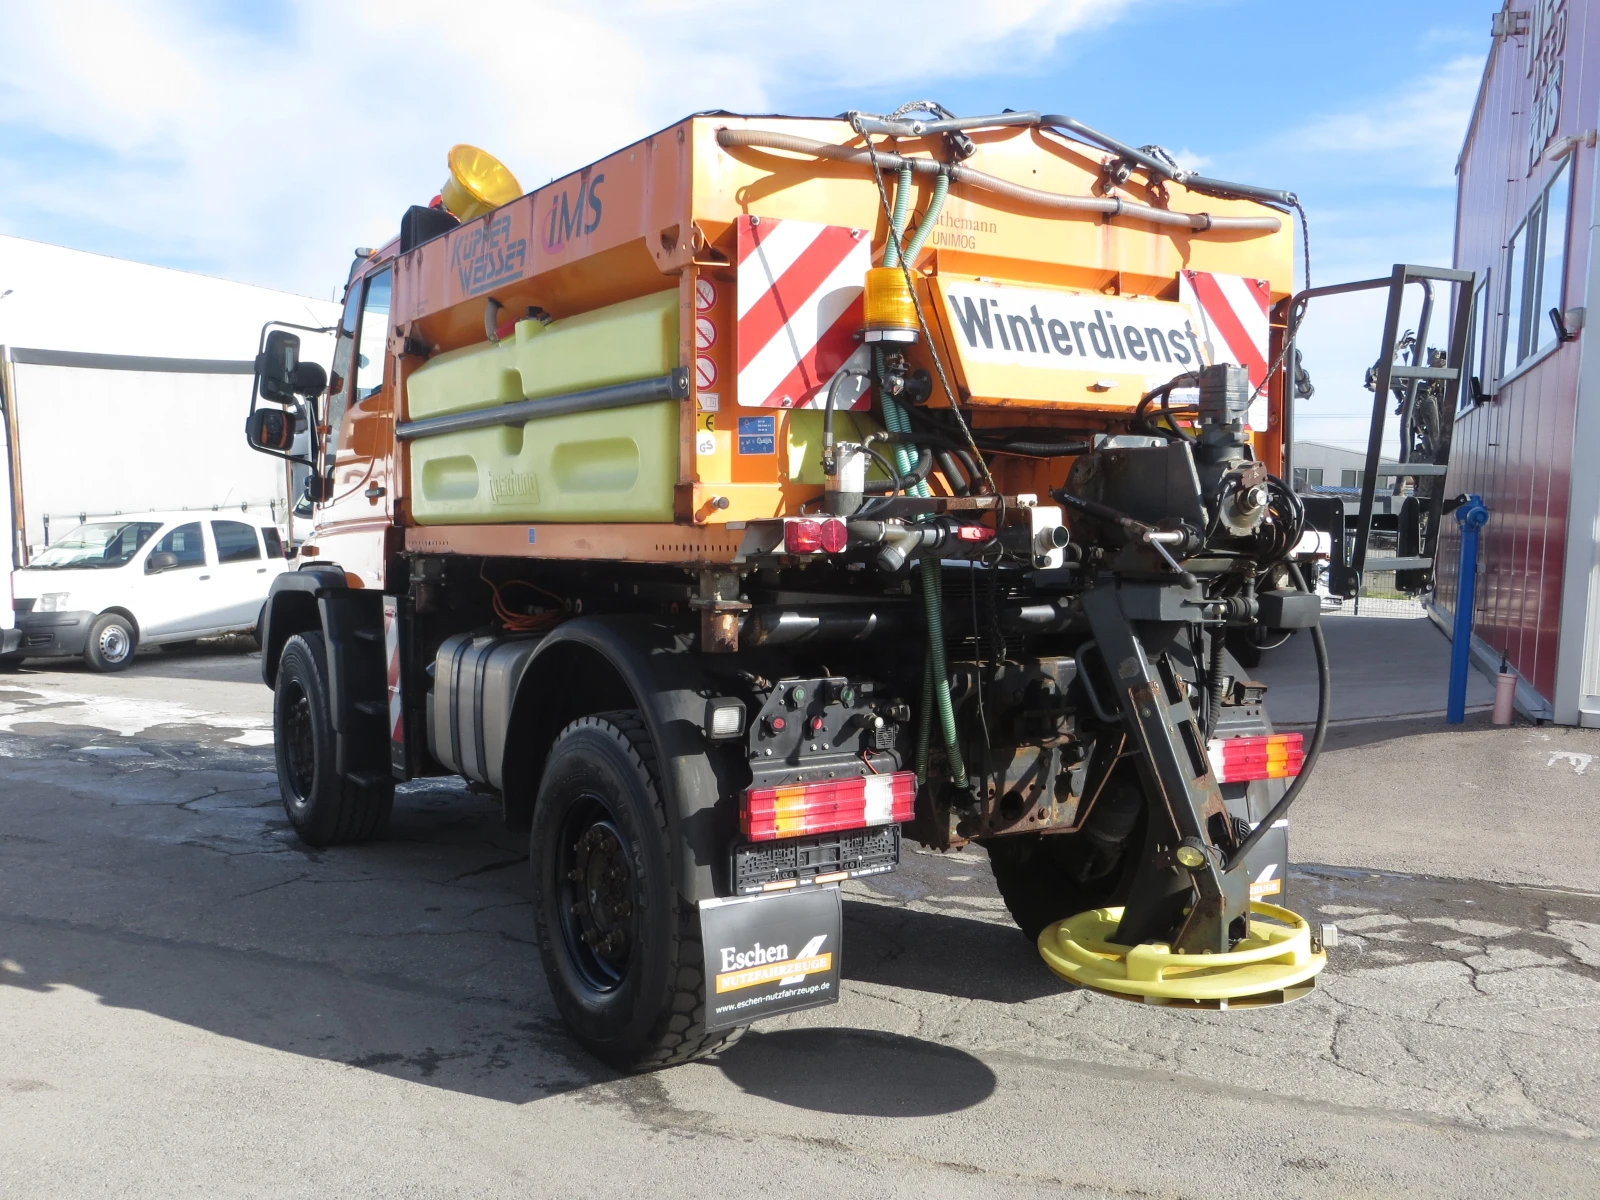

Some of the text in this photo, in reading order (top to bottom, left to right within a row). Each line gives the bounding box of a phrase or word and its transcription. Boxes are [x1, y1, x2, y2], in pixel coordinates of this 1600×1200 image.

[932, 231, 975, 250] UNIMOG
[948, 294, 1203, 366] Winterdienst
[720, 942, 788, 973] Eschen
[721, 957, 827, 989] NUTZFAHRZEUGE
[715, 981, 830, 1014] www.eschen-nutzfahrzeuge.de
